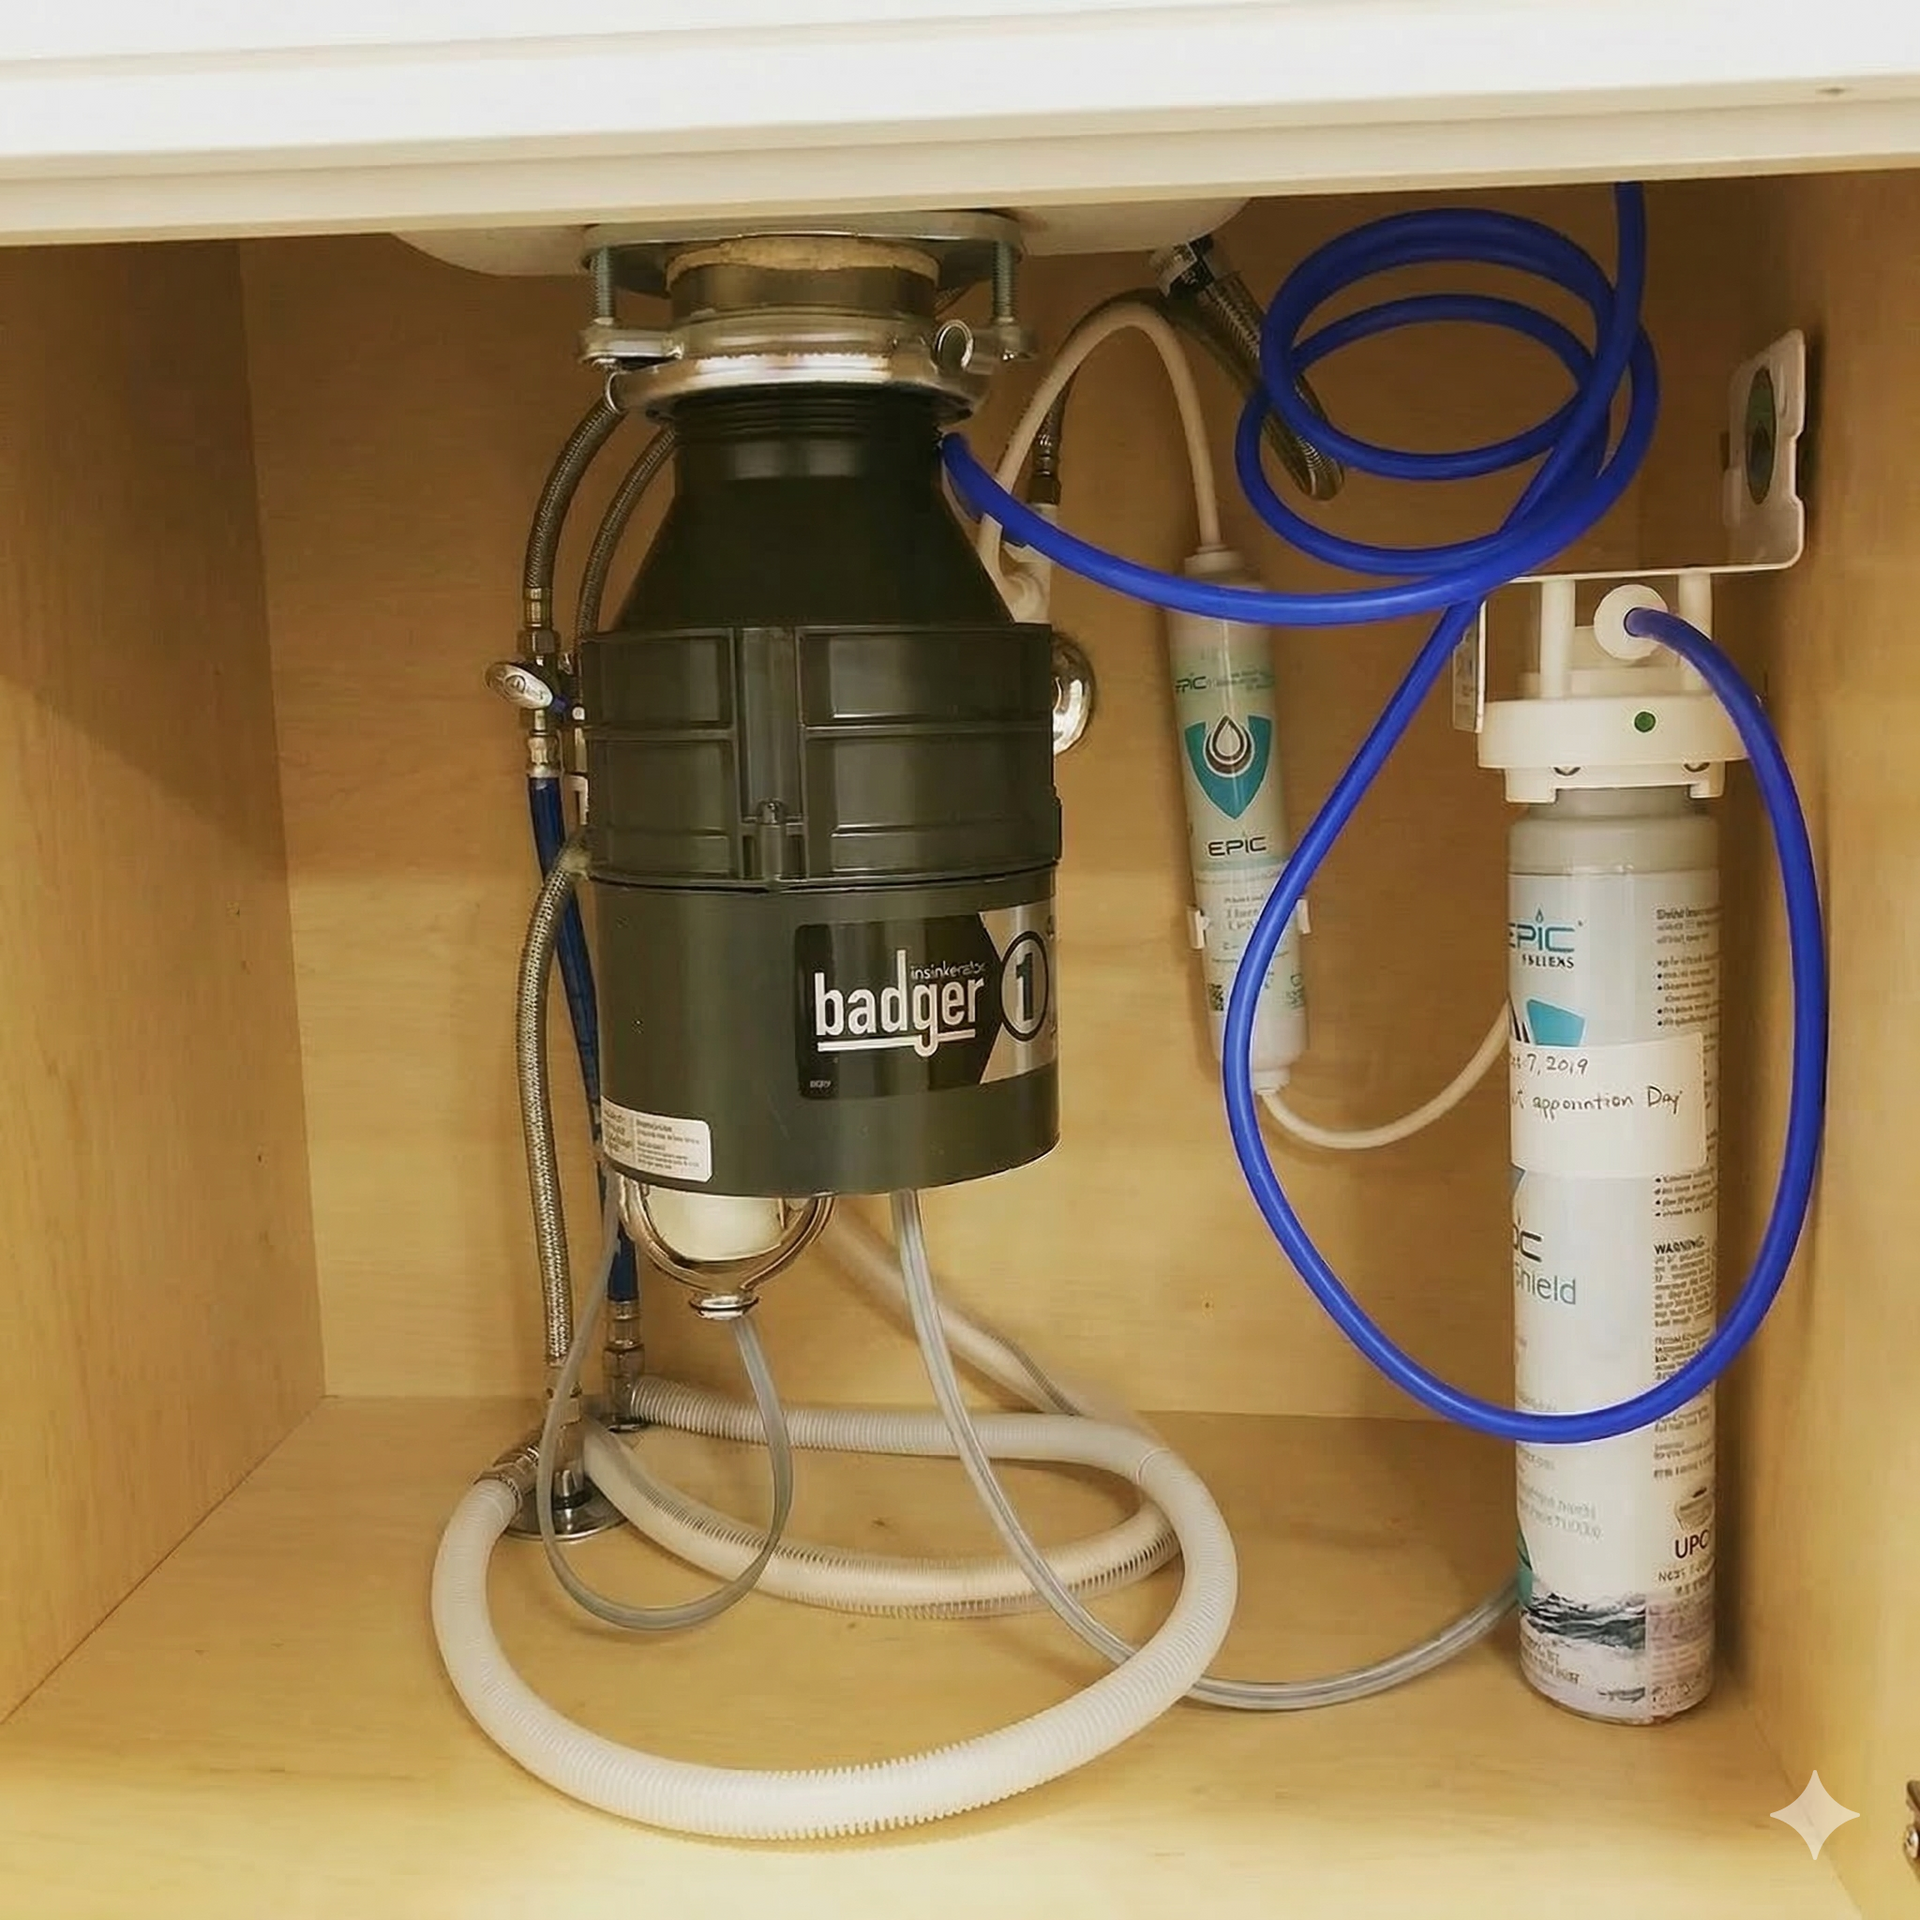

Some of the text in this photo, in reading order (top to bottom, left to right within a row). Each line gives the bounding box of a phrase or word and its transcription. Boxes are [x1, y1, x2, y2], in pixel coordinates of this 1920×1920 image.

[1208, 836, 1267, 857] EPIC
[814, 949, 985, 1057] badger
[1015, 951, 1035, 1022] 1
